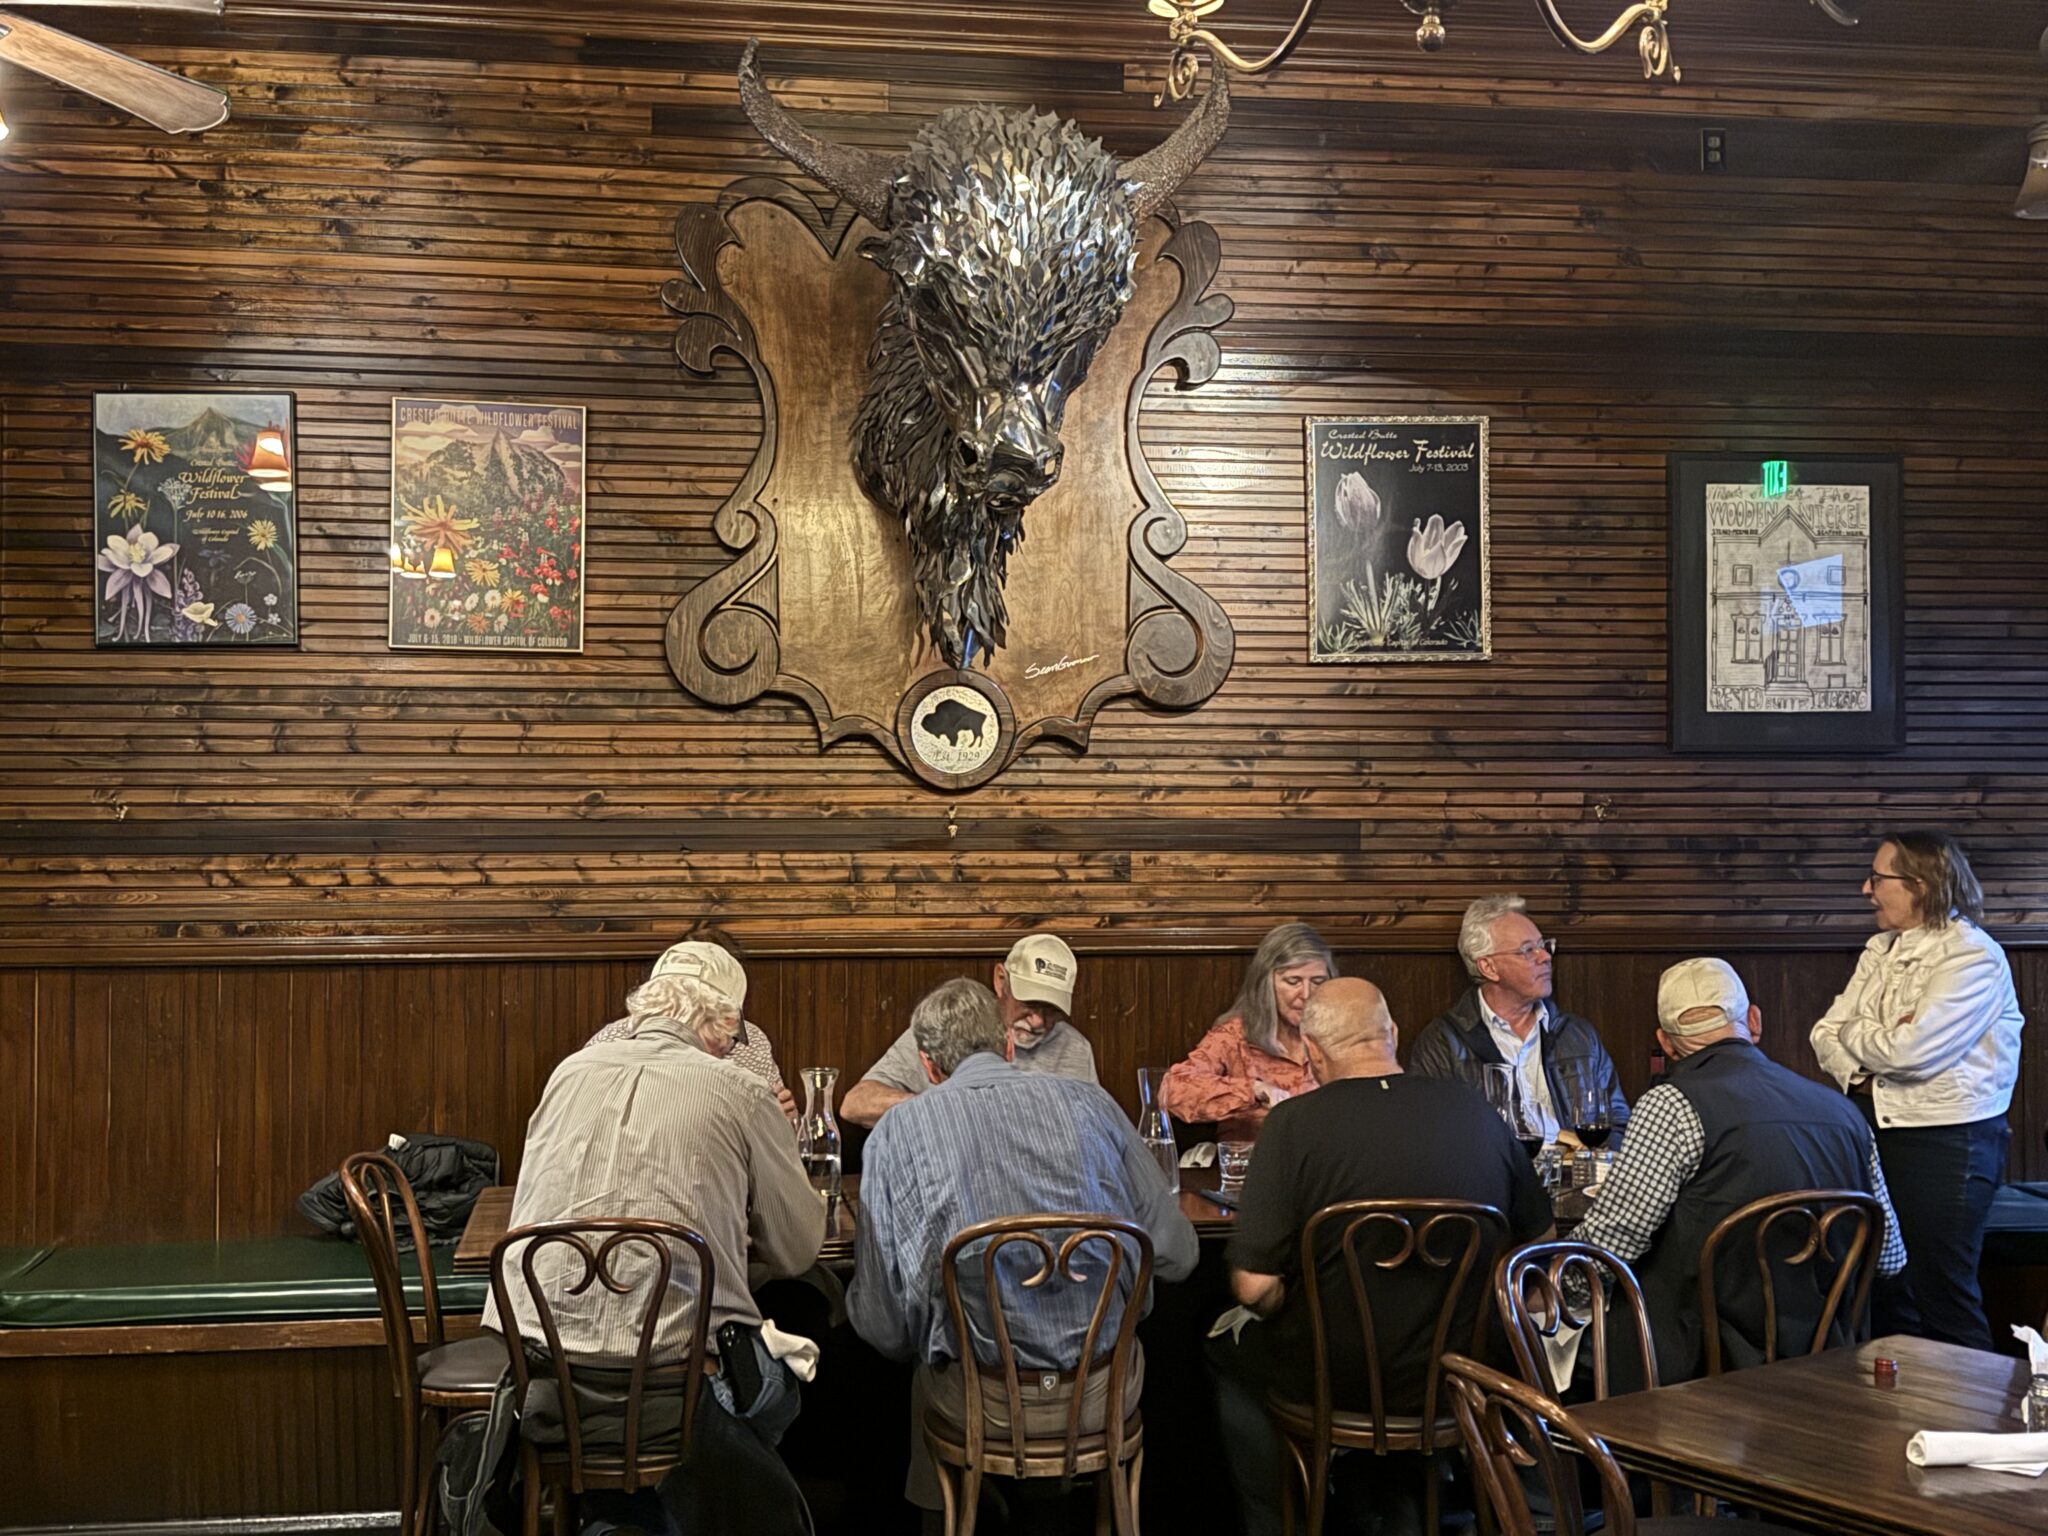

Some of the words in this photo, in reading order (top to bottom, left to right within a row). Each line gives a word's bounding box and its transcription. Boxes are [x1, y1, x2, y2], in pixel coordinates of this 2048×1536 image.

[400, 407, 440, 424] CRESTED
[476, 411, 534, 427] WILDFLOWER
[537, 413, 577, 430] FESTIVAL
[1328, 429, 1366, 439] Crested
[1368, 429, 1398, 439] Butte
[1320, 440, 1410, 466] Wildflower
[1413, 439, 1475, 463] Festival
[178, 467, 247, 489] Wildflower
[1408, 463, 1425, 474] July
[186, 484, 246, 504] Festival
[183, 507, 205, 523] July
[1709, 501, 1778, 528] WOODEN
[1799, 503, 1867, 529] NICKEL
[957, 751, 980, 762] 1929
